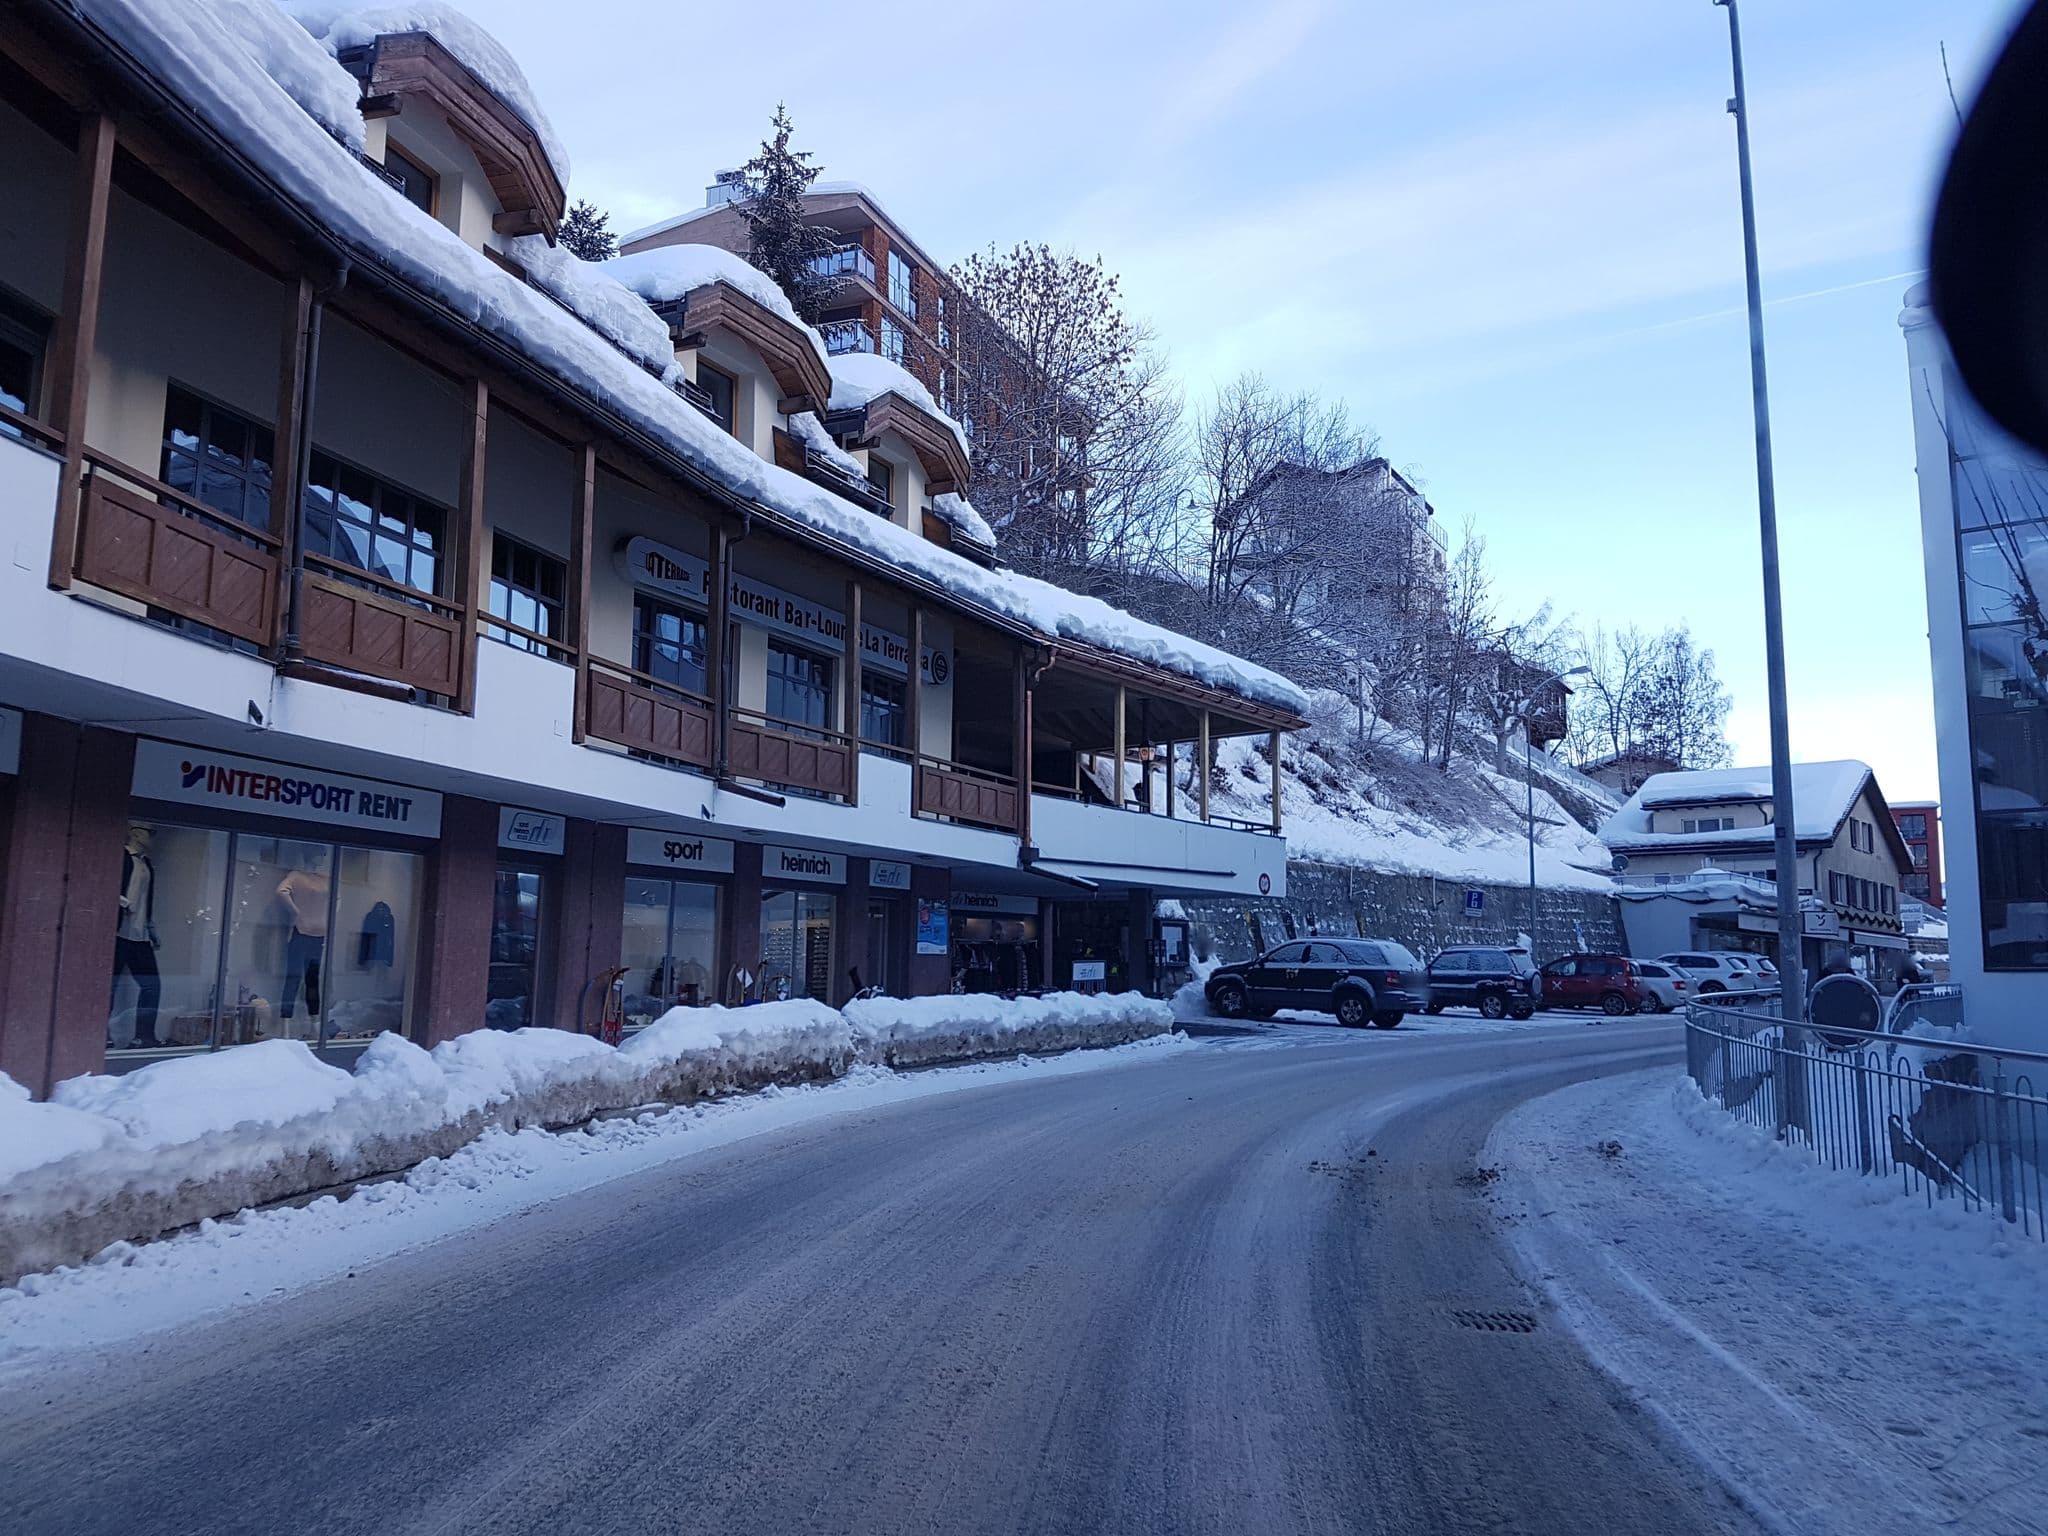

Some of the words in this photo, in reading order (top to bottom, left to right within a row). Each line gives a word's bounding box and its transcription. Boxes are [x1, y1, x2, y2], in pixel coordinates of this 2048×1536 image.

[702, 570, 780, 620] Rtorant
[865, 628, 879, 653] La
[882, 635, 929, 671] Terraa
[207, 765, 355, 813] INTERSPORT
[358, 791, 412, 821] RENT
[663, 840, 704, 862] sport
[780, 852, 831, 875] heinrich
